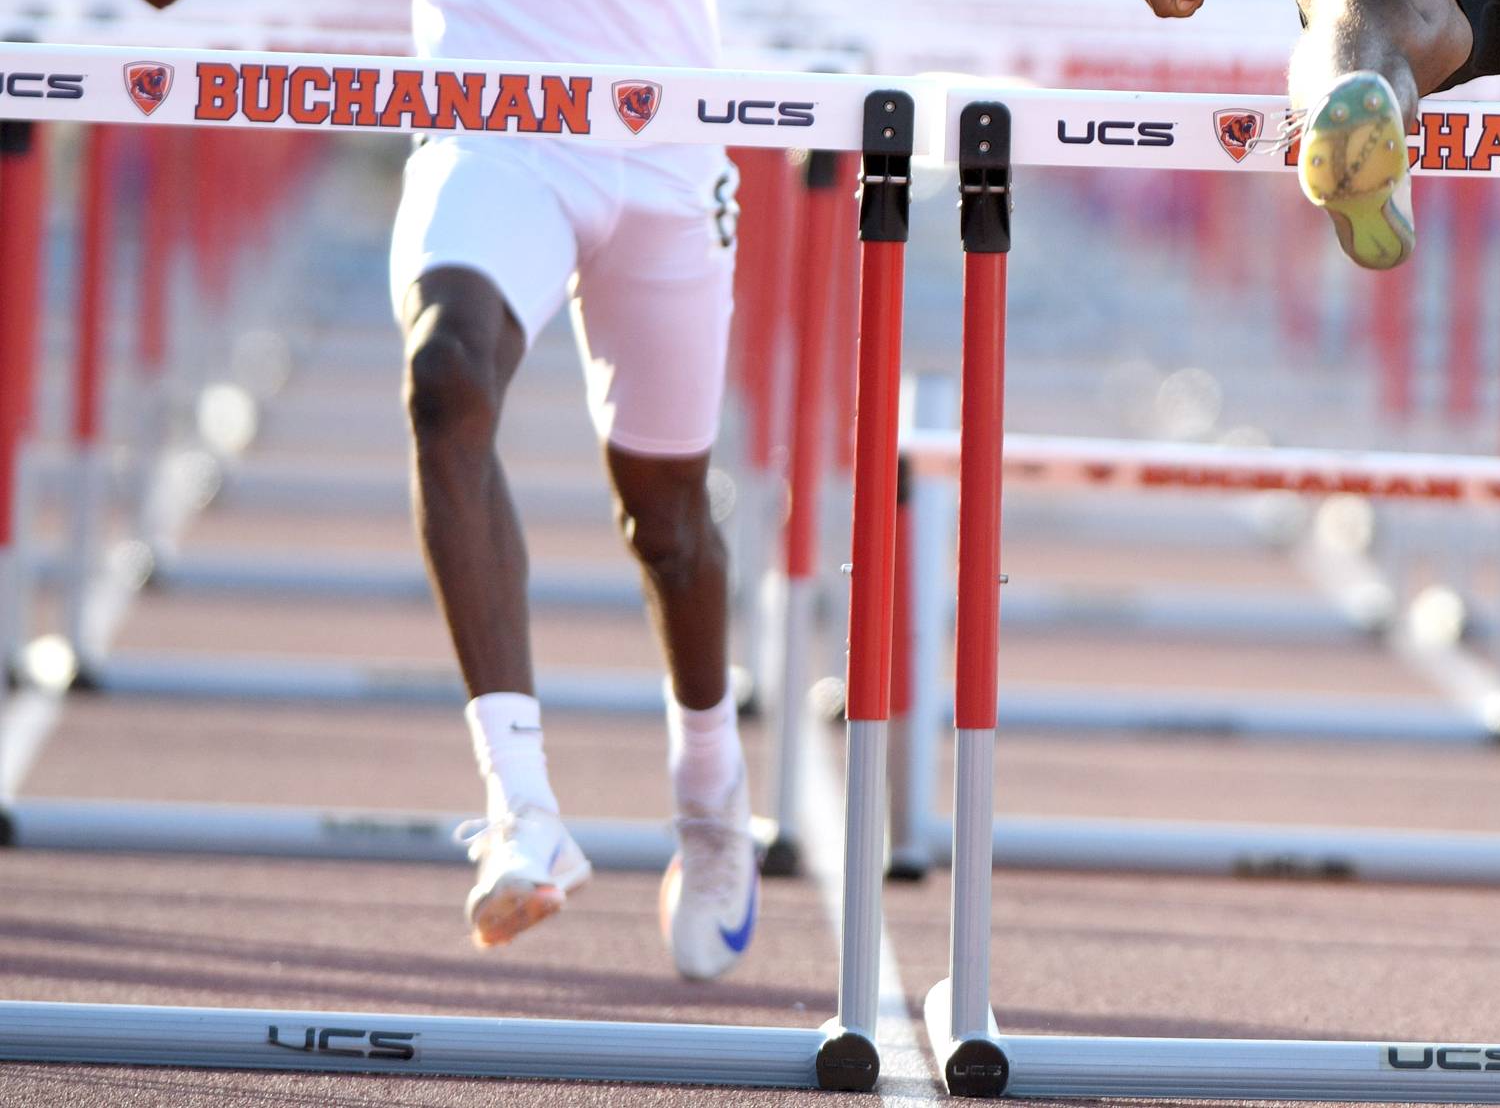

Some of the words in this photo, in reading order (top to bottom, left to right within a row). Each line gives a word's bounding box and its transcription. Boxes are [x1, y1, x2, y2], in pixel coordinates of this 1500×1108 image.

[0, 71, 85, 100] CS
[194, 61, 593, 135] BUCHANAN
[697, 98, 816, 127] UCS
[1057, 119, 1175, 147] UCS
[268, 1024, 416, 1061] UCS
